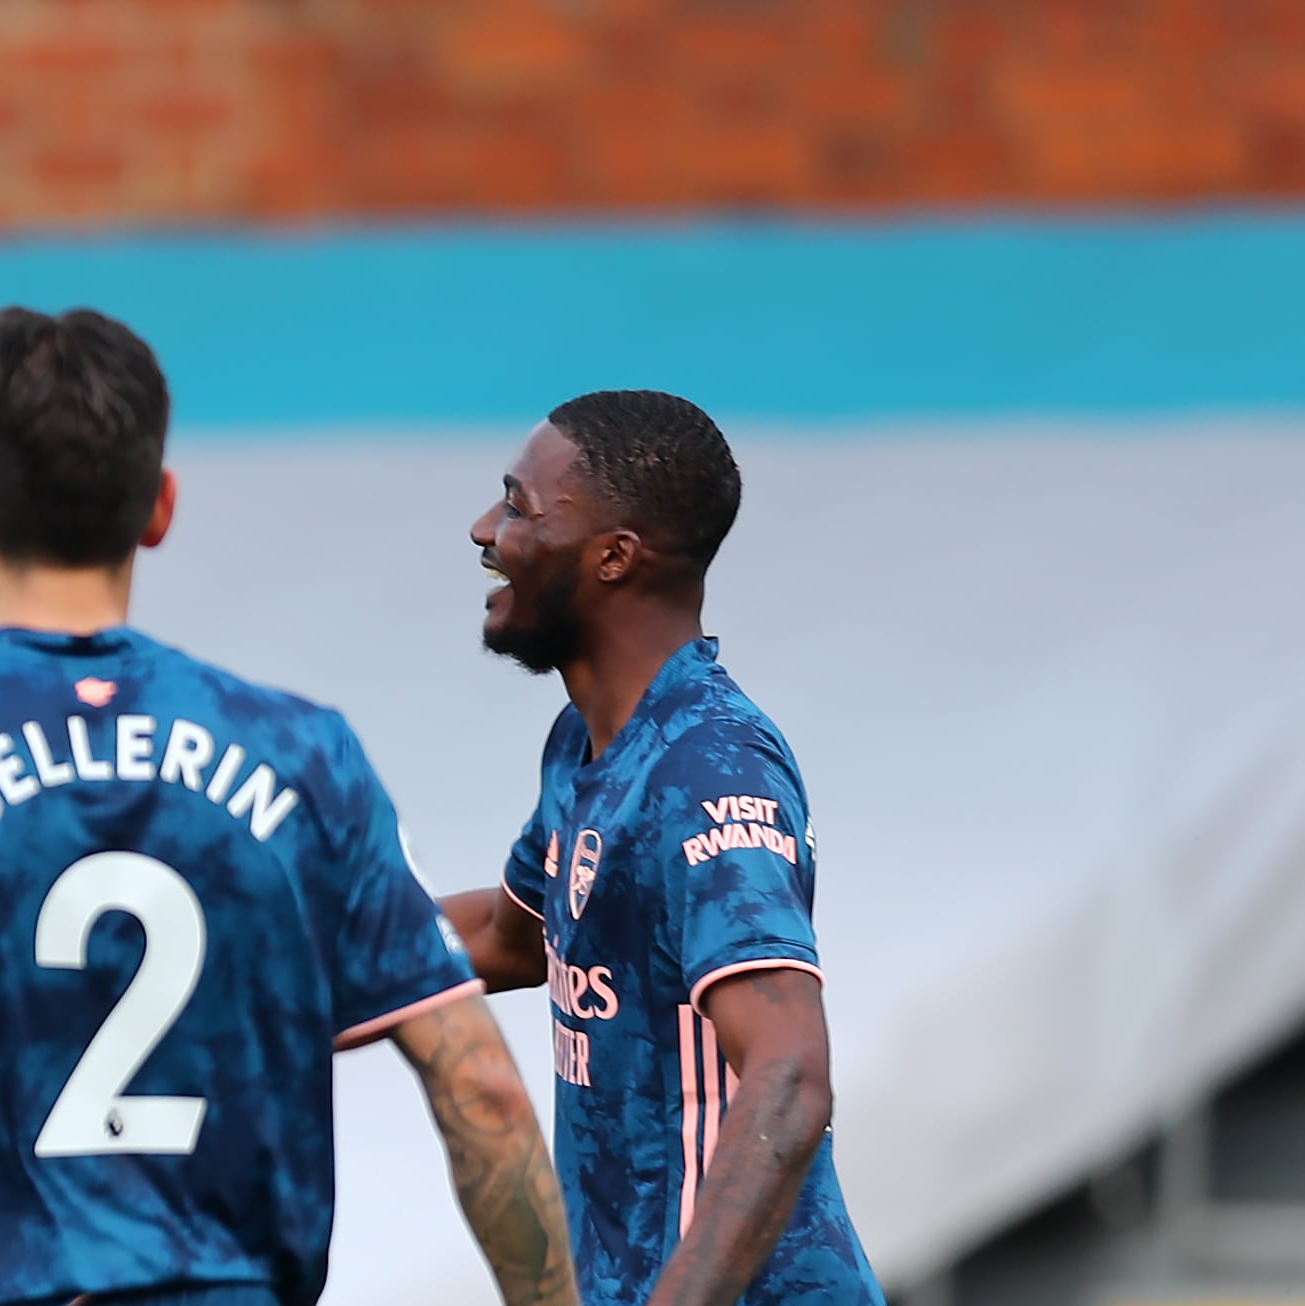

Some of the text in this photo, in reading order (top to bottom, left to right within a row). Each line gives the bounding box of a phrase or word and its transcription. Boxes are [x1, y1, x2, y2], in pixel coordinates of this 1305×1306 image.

[701, 795, 778, 825] VISIT
[682, 822, 797, 867] RWANDA
[35, 850, 207, 1158] 2
